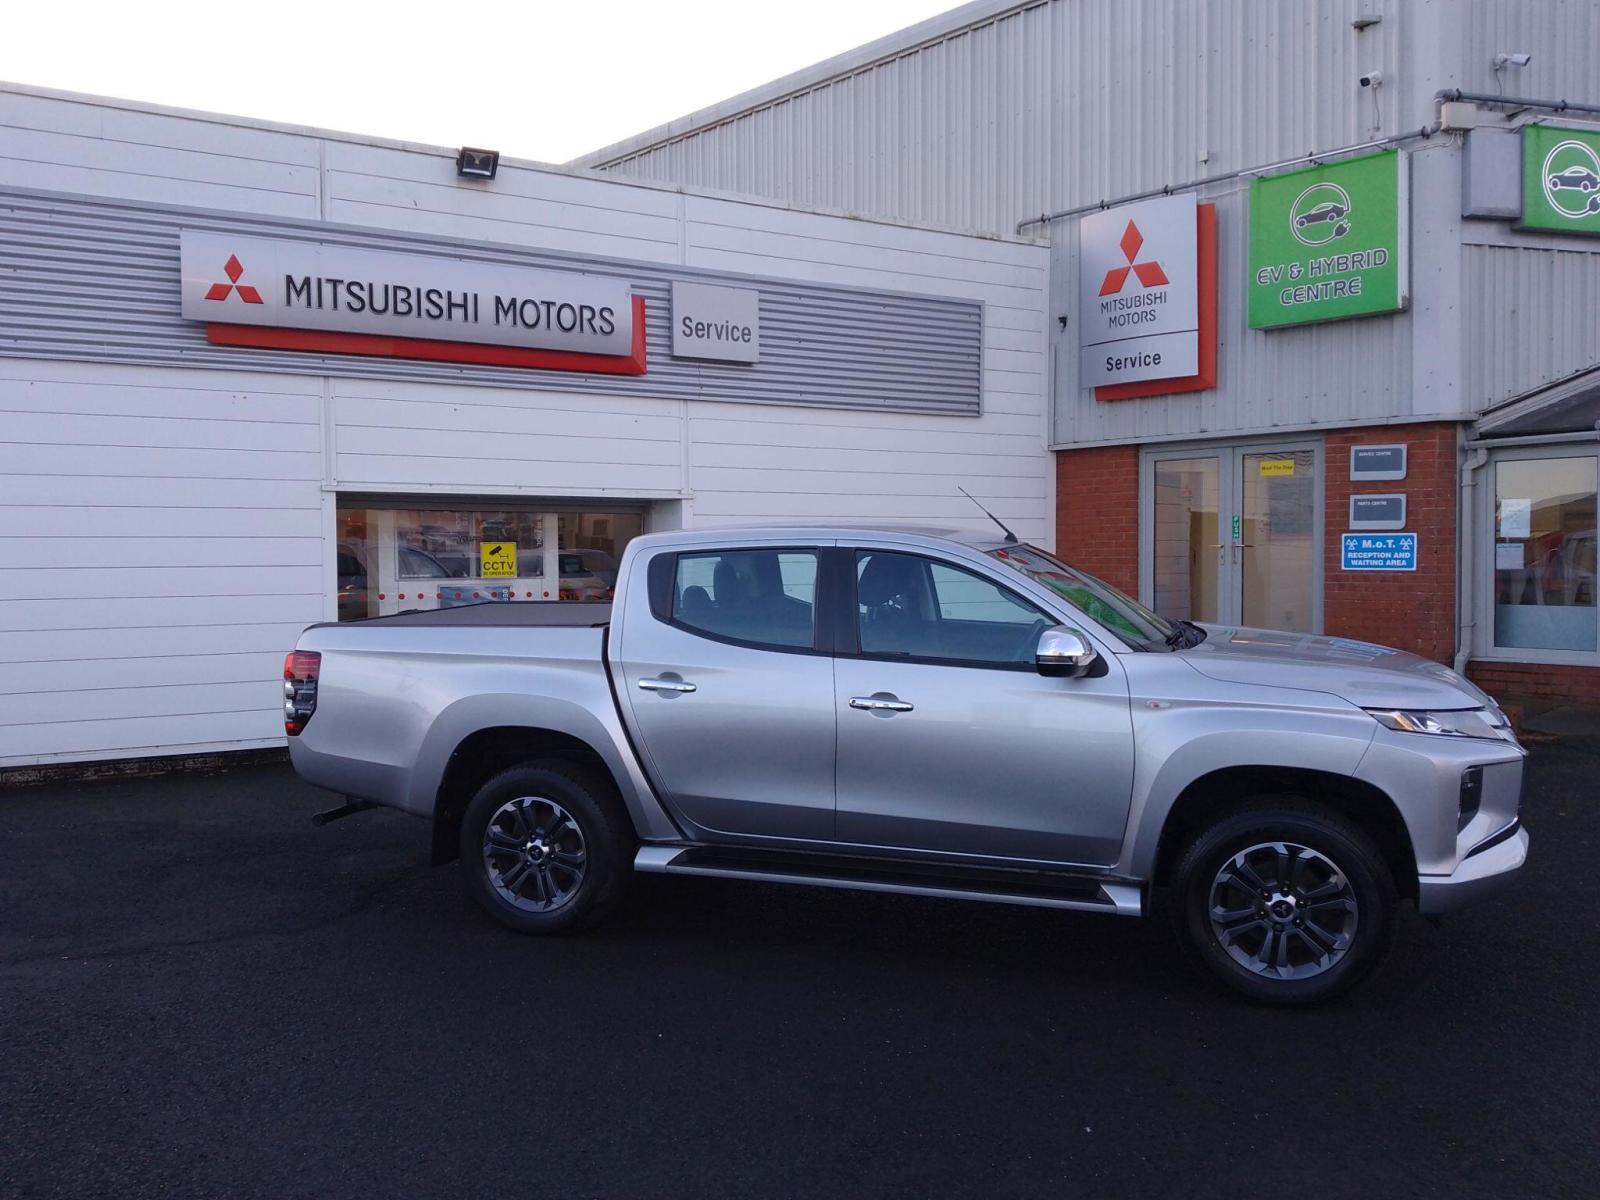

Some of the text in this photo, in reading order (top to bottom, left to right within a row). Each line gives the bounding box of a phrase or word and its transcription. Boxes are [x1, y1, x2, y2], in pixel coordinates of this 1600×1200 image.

[1256, 247, 1389, 287] EV & HYBRID
[1100, 291, 1168, 315] MITSUBISHI
[1279, 277, 1362, 307] CENTRE
[283, 273, 616, 336] MITSUBISHI MOTORS
[681, 315, 752, 344] Service
[1108, 309, 1157, 329] MOTORS
[1105, 350, 1162, 372] Service
[1362, 539, 1396, 548] M.o.T.
[483, 561, 514, 571] CCTV
